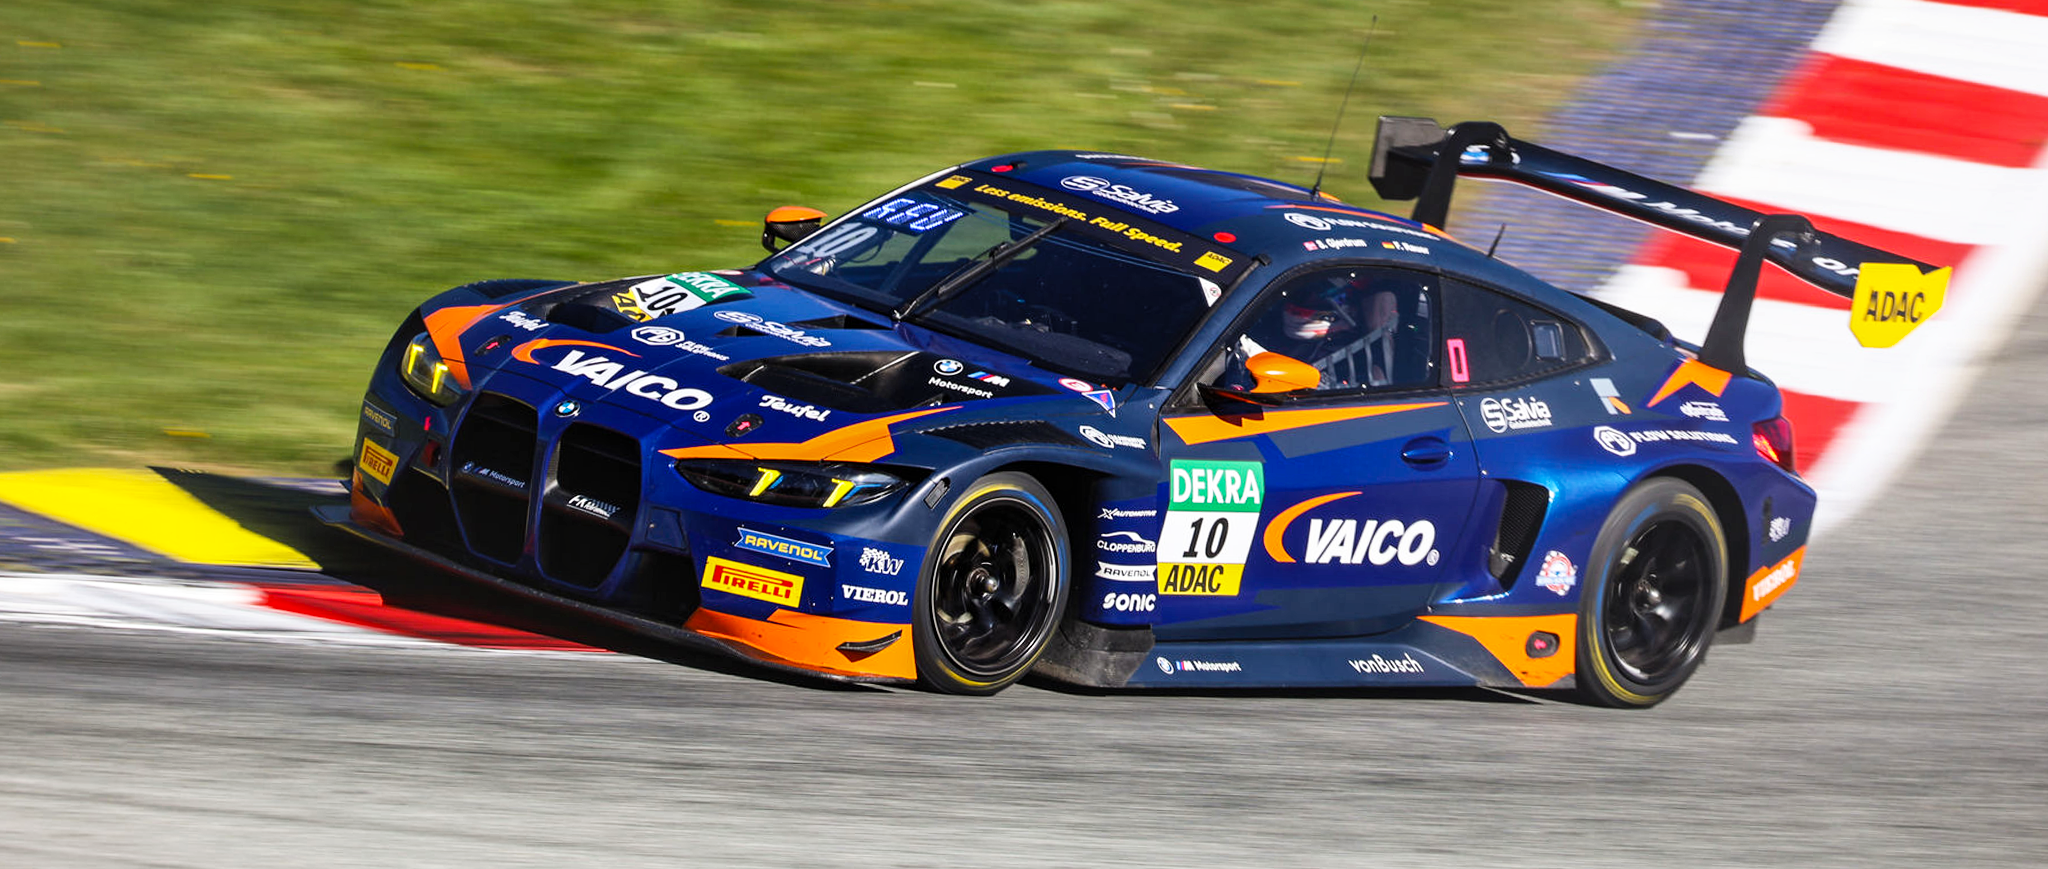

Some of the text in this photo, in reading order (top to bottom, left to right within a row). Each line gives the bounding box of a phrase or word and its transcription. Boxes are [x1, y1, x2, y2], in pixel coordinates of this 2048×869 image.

[1100, 185, 1180, 213] Salvia
[974, 184, 1183, 253] Less emissions. Full Speed.
[636, 286, 688, 311] 10
[1864, 290, 1925, 323] ADAC
[551, 350, 714, 411] VAICO
[928, 376, 994, 398] Motorsport
[364, 406, 392, 430] RAVENOL
[759, 394, 831, 422] Teufel
[1501, 396, 1552, 420] Salvia
[1629, 429, 1673, 443] FLOW
[362, 445, 393, 478] PIRELLI
[489, 469, 525, 489] Motorsport
[1172, 468, 1260, 504] DEKRA
[744, 535, 823, 561] RAVENOL
[1097, 540, 1156, 553] CLOPPENBURG
[1182, 517, 1229, 559] 10
[1304, 518, 1436, 566] VAICO
[712, 565, 793, 599] PIRELLI
[1103, 566, 1151, 578] RAVENOL
[1164, 565, 1224, 593] ADAC
[841, 584, 909, 606] VIEROL
[1194, 660, 1241, 673] Motorsport
[1349, 652, 1425, 675] vonBusch
